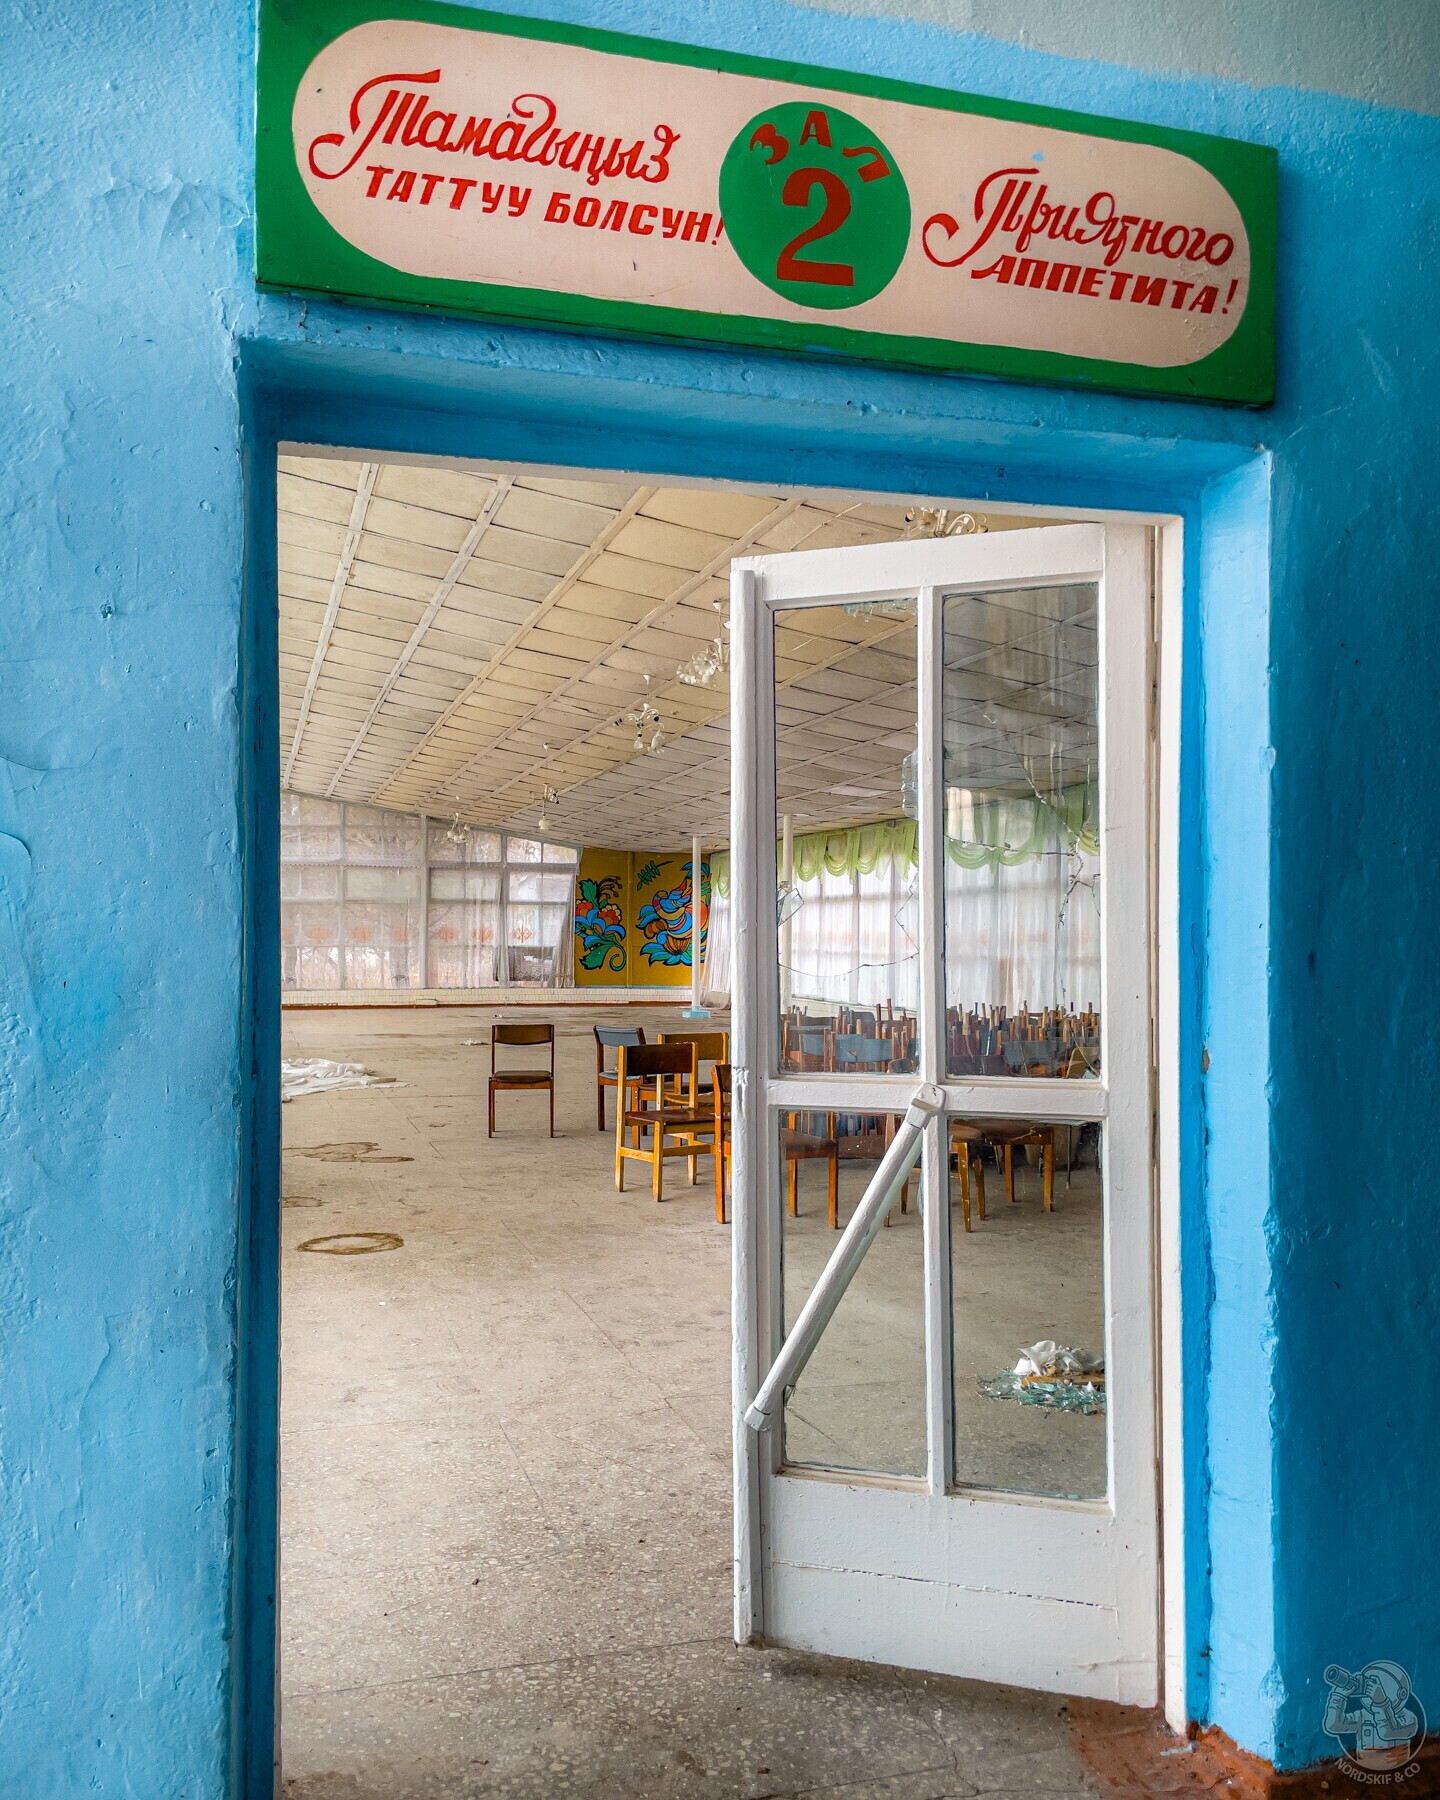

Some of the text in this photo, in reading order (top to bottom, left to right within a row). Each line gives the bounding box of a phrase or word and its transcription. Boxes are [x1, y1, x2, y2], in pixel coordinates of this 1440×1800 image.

[308, 69, 681, 186] Тамадыңыз
[749, 110, 891, 183] ЗАЛ
[366, 164, 725, 246] ТАТТУУ БОЛСУН!
[776, 166, 854, 287] 2
[922, 167, 1235, 268] Приятного
[970, 253, 1238, 315] АППЕТИТА!
